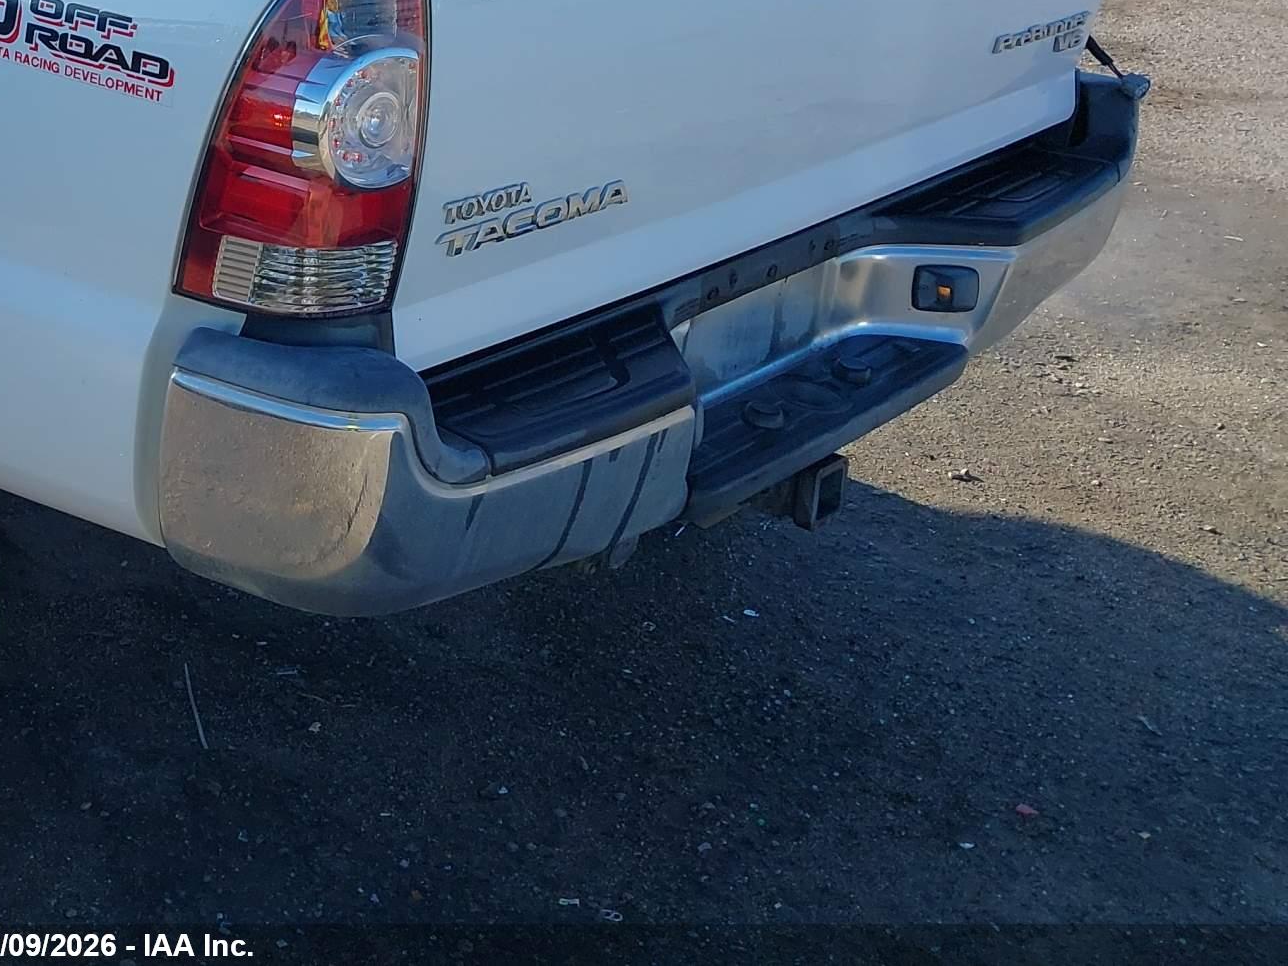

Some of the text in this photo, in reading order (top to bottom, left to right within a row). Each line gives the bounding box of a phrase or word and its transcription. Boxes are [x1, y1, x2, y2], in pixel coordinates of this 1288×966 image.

[14, 52, 60, 74] RACING
[64, 66, 162, 102] DEVELOPMENT
[24, 22, 175, 87] ROAD
[435, 179, 629, 257] TACOMA
[442, 182, 532, 224] TOYOTA
